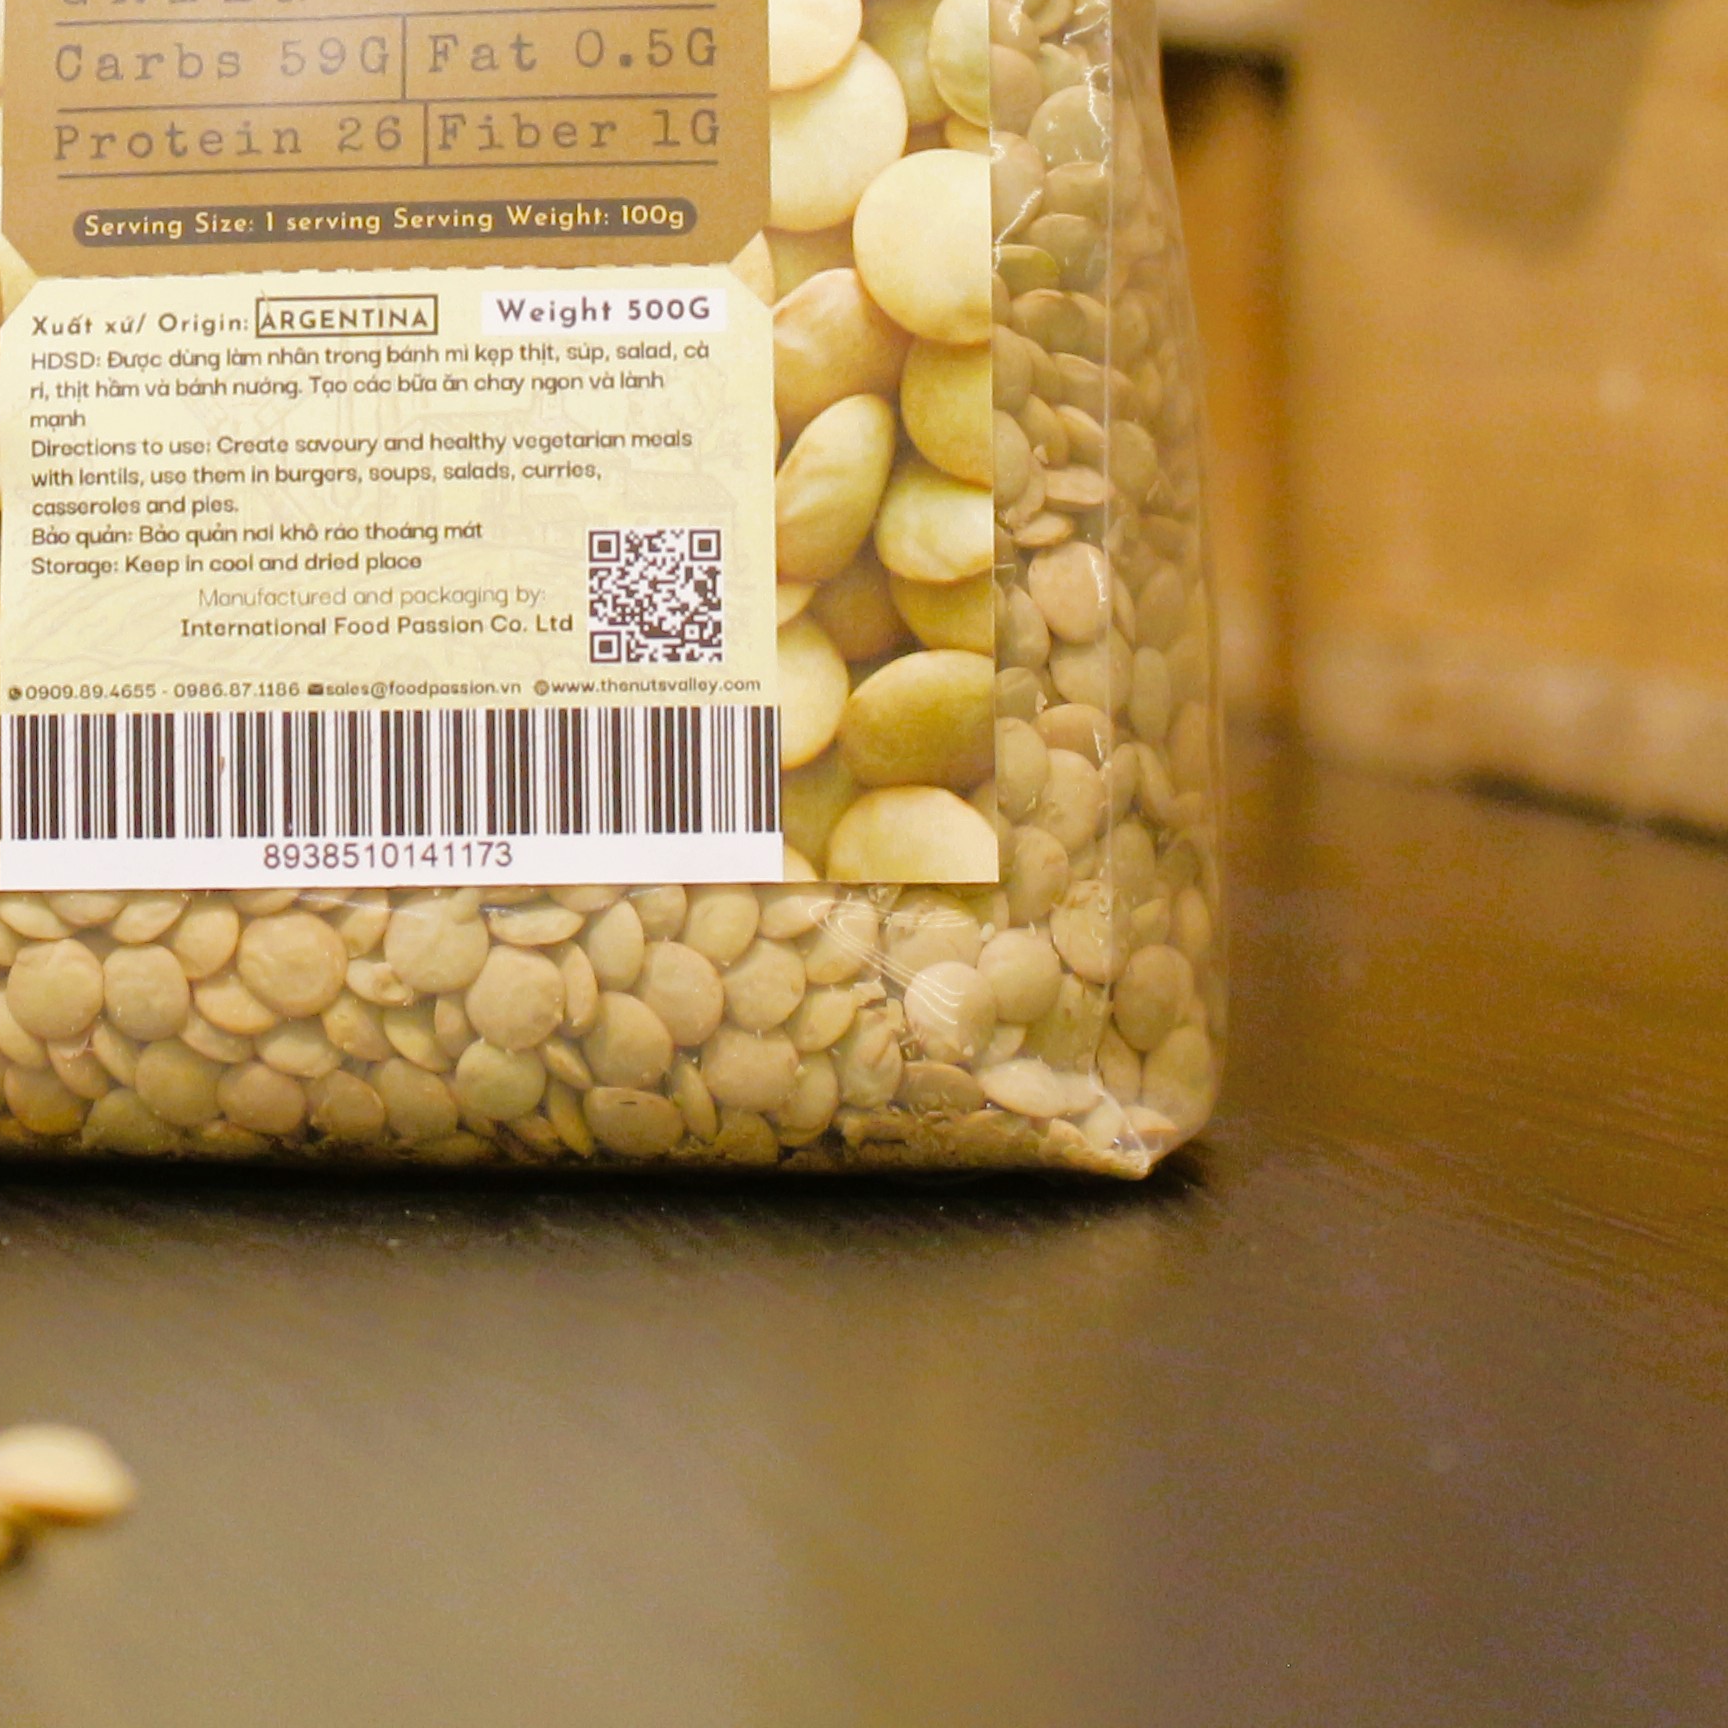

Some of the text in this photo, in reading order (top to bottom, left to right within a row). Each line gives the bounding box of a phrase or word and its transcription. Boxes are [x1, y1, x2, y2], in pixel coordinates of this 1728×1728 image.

[54, 38, 390, 82] Carbs 59G
[427, 27, 718, 73] Fat 0.5G
[53, 115, 403, 161] Protein 26
[437, 108, 720, 151] Fiber 1G
[84, 202, 686, 238] Serving Size: 1 serving Serving Weight: 100g
[32, 314, 93, 336] Xuất
[158, 312, 249, 337] Origin:
[260, 308, 428, 330] ARGENTINA
[497, 296, 711, 328] Weight 500G
[31, 351, 101, 370] HDSD:
[108, 351, 162, 373] Được
[169, 349, 220, 371] dùng
[227, 347, 262, 366] làm
[267, 347, 319, 366] nhân
[325, 348, 381, 369] trong
[386, 344, 439, 363] bánh
[445, 344, 469, 362] mì
[475, 343, 513, 366] kẹp
[519, 342, 560, 366] thịt,
[616, 340, 678, 361] salad,
[56, 380, 89, 402] thịt
[95, 377, 139, 398] hầm
[144, 378, 170, 396] và
[176, 377, 227, 397] bánh
[309, 376, 347, 398] Tạo
[353, 375, 391, 393] các
[398, 374, 437, 392] bữa
[443, 373, 468, 391] ăn
[474, 373, 525, 396] chay
[531, 375, 584, 395] ngon
[589, 371, 614, 389] và
[620, 370, 664, 388] lành
[30, 409, 86, 432] mạnh
[31, 430, 693, 458] Directions to use: Create savoury and healthy vegetarian meals
[32, 460, 602, 487] with lentils, use them in burgers, soups, salads, curries,
[32, 496, 239, 518] casseroles and pies.
[32, 525, 69, 545] Bảo
[75, 524, 133, 549] quản:
[139, 524, 179, 543] Bảo
[185, 522, 237, 548] quản
[280, 522, 319, 541] khô
[325, 522, 359, 541] ráo
[365, 521, 438, 544] thoáng
[444, 520, 482, 539] mát
[31, 551, 422, 579] Storage: Keep in cool and dried place
[199, 584, 546, 610] Manufactured and packaging by:
[181, 613, 573, 637] International Food Passion Co. Ltd
[25, 683, 156, 700] 0909.89.4655
[174, 681, 300, 698] 0986.87.1186
[326, 679, 521, 699] sales@foodpassion.vn
[552, 677, 761, 696] www.thenutsvalley.com
[264, 841, 513, 869] 8938510141173
